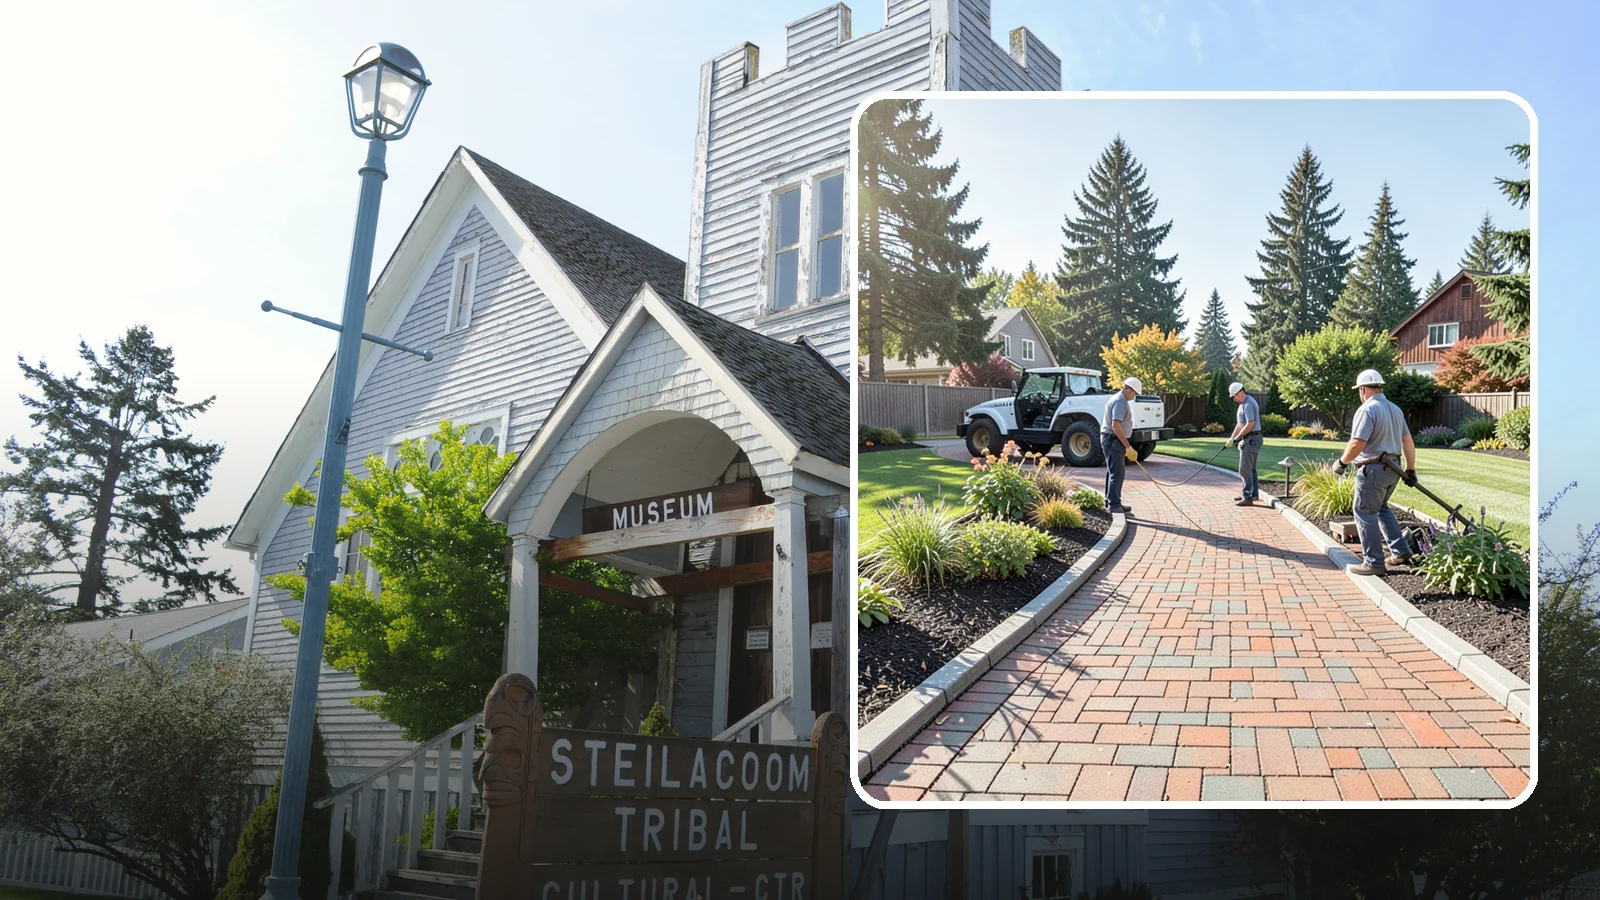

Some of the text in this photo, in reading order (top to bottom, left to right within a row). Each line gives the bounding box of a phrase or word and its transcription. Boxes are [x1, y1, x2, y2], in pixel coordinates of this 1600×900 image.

[613, 491, 713, 530] MUSEUM
[551, 738, 810, 793] STEILACOOM
[615, 807, 758, 851] TRIBAL
